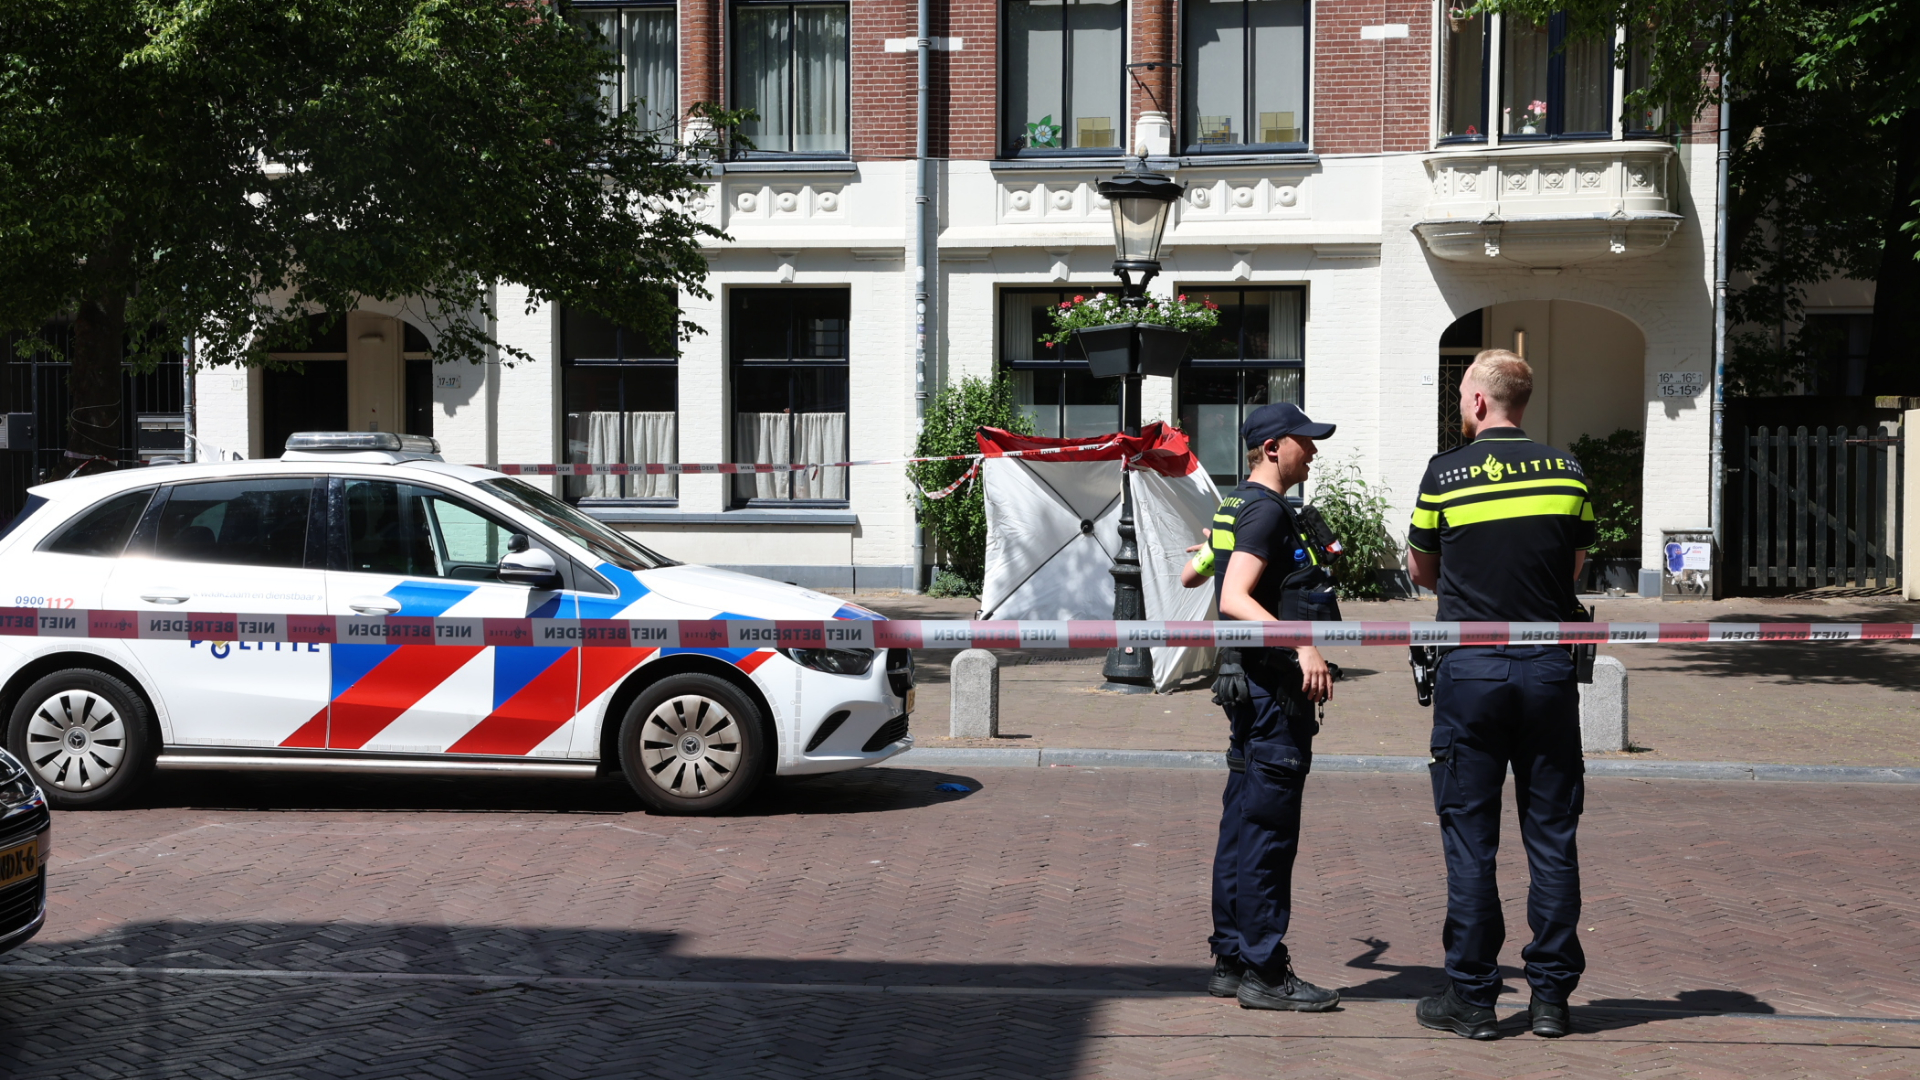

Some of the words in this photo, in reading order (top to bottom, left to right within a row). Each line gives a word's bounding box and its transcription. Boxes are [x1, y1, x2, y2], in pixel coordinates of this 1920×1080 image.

[1659, 373, 1673, 383] 16A
[1469, 454, 1566, 482] POLITIE
[15, 595, 44, 605] 0900
[265, 591, 315, 601] dienstbaar
[46, 597, 75, 609] 112
